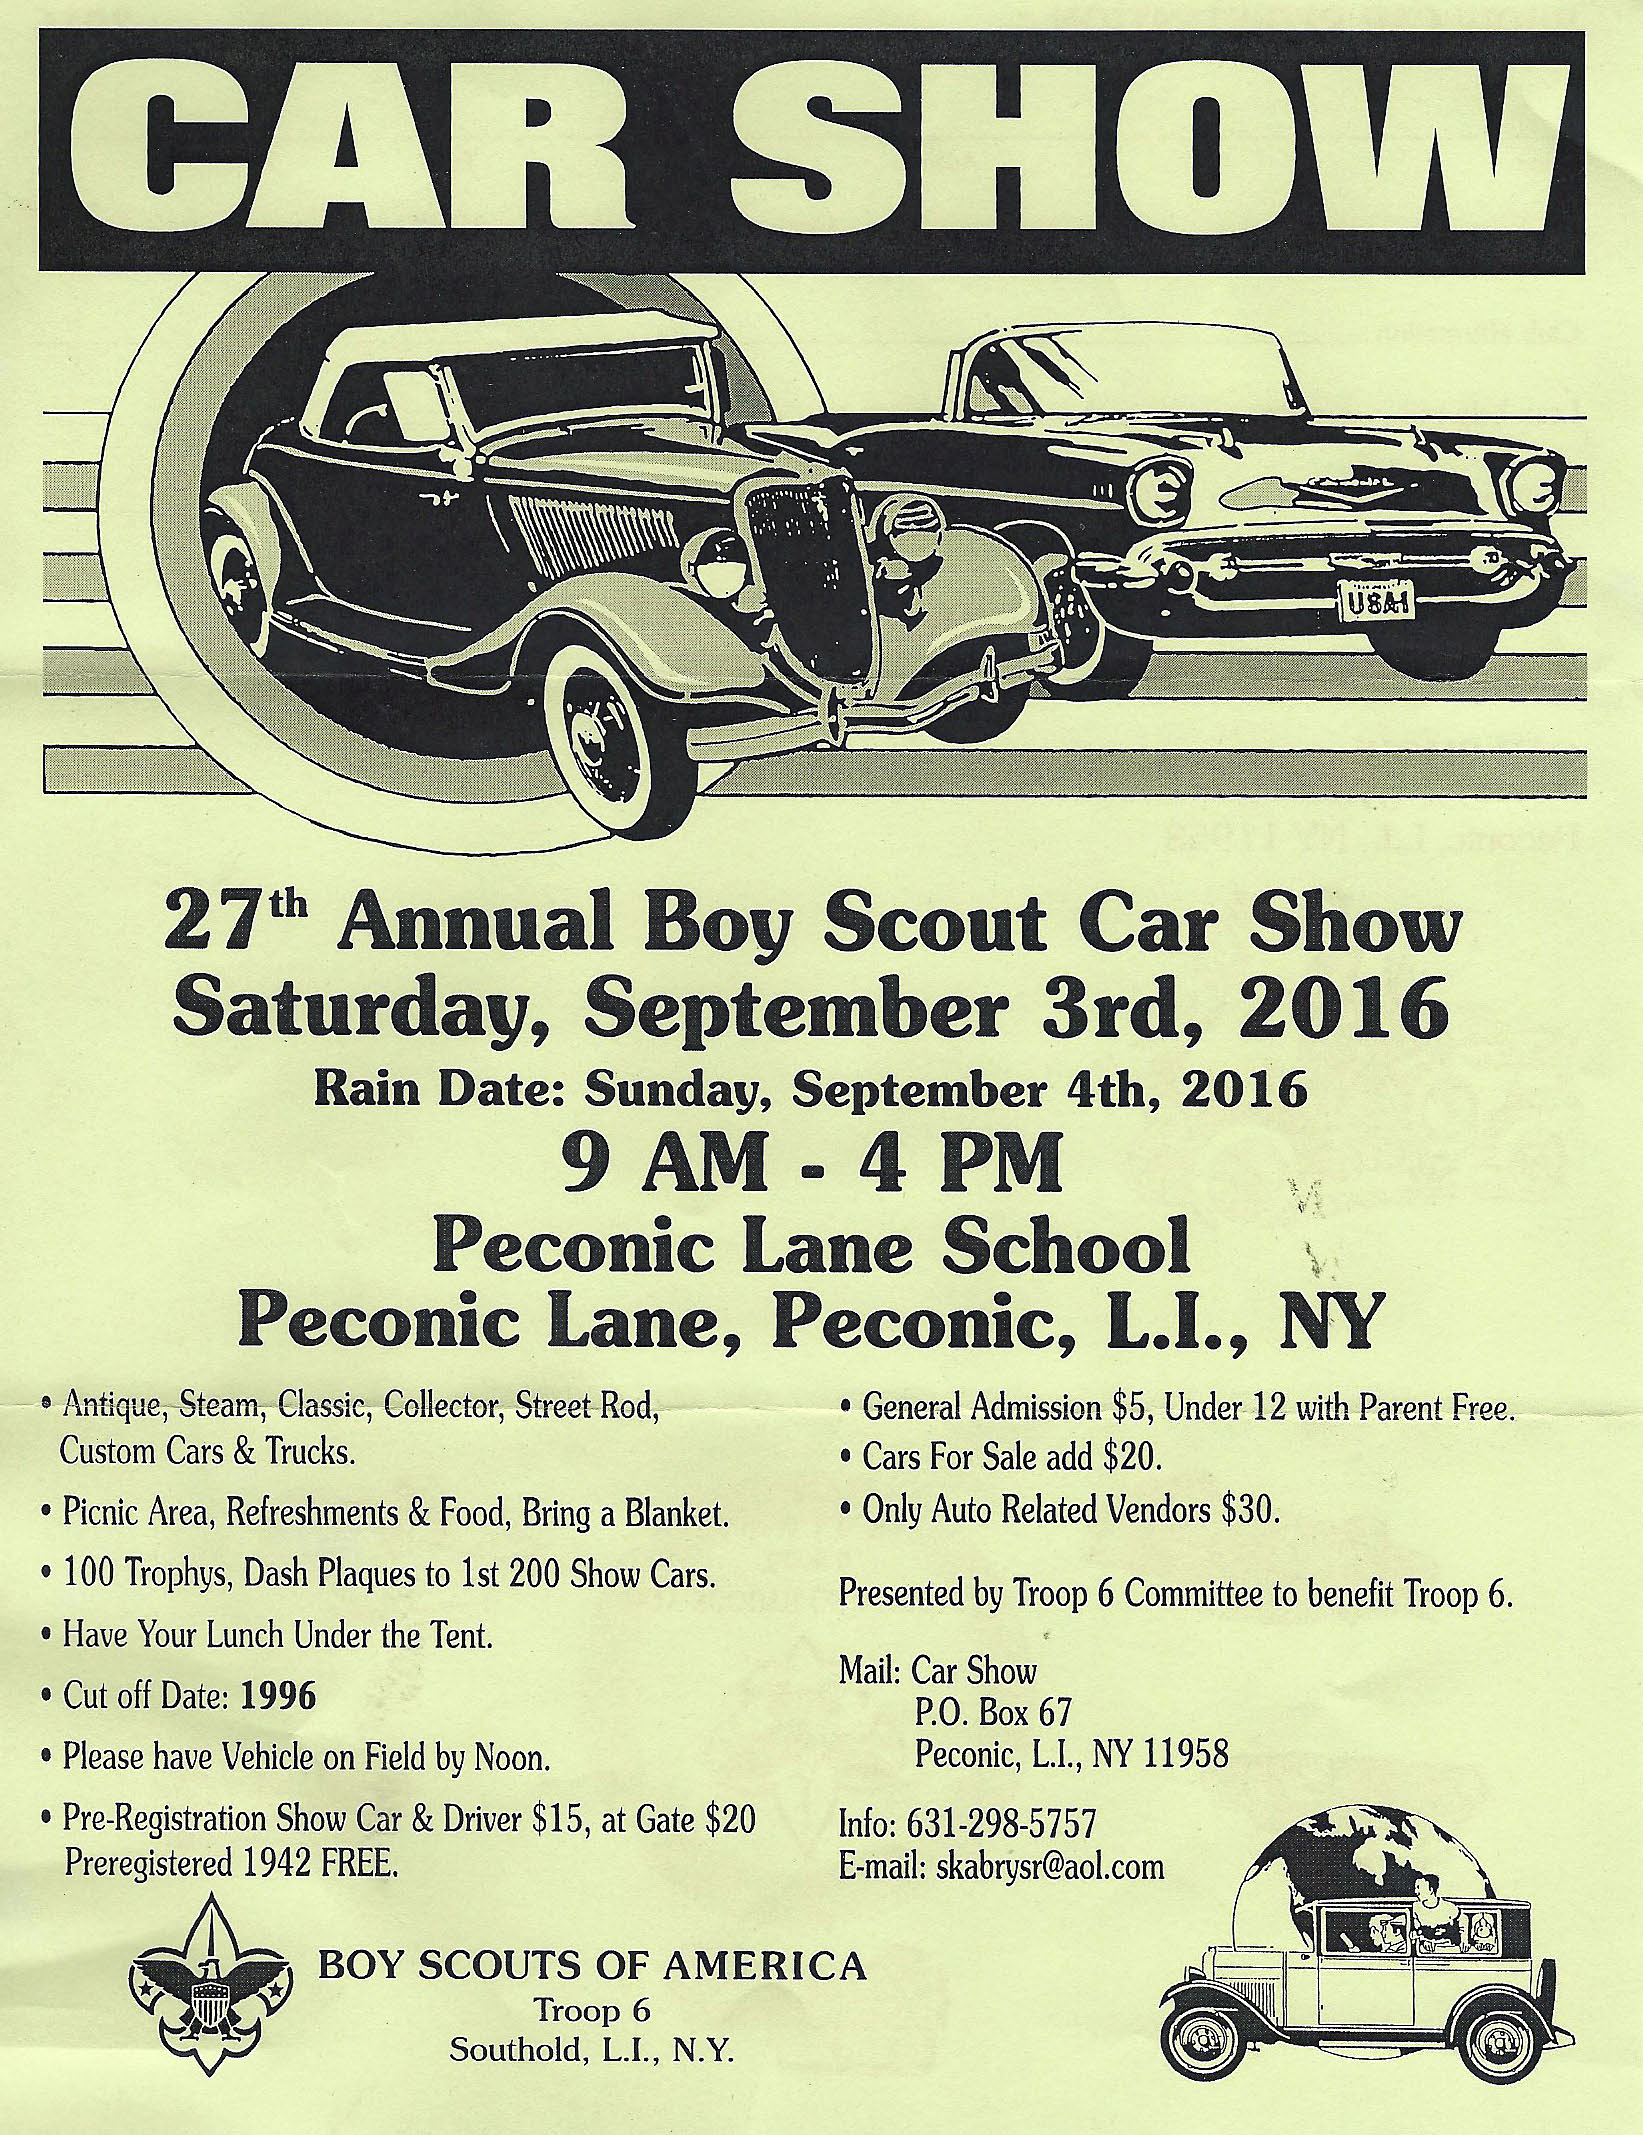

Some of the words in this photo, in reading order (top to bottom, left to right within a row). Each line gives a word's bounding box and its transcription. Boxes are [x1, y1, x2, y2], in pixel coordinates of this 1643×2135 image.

[70, 57, 637, 235] CAR
[730, 56, 1571, 238] SHOW
[164, 885, 309, 950] 27th
[336, 886, 615, 951] Annual
[644, 888, 795, 966] Boy
[823, 888, 1048, 952] Scout
[1079, 888, 1220, 953] Car
[1250, 887, 1464, 953] Show
[173, 972, 550, 1052] Saturday,
[584, 973, 1010, 1052] September
[1042, 973, 1203, 1049] 3rd,
[1239, 975, 1449, 1040] 2016
[314, 1067, 421, 1106] Rain
[438, 1068, 564, 1107] Date:
[584, 1067, 772, 1116] Sunday,
[792, 1068, 1049, 1116] September
[1067, 1068, 1160, 1114] 4th,
[1182, 1069, 1308, 1108] 2016
[561, 1129, 610, 1193] 9
[641, 1130, 770, 1192] AM
[859, 1130, 907, 1193] 4
[940, 1130, 1064, 1193] PM
[433, 1213, 715, 1273] Peconic
[742, 1214, 913, 1274] Lane
[942, 1213, 1191, 1275] School
[238, 1288, 520, 1348] Peconic
[547, 1289, 741, 1358] Lane,
[772, 1290, 1076, 1360] Peconic,
[1107, 1290, 1248, 1360] L.I.,
[1279, 1290, 1387, 1350] NY
[62, 1388, 168, 1425] Antique,
[179, 1388, 266, 1424] Steam,
[278, 1387, 372, 1425] Classic,
[384, 1388, 505, 1425] Collector,
[515, 1389, 592, 1420] Street
[600, 1389, 659, 1425] Rod,
[863, 1389, 962, 1421] General
[970, 1390, 1103, 1421] Admission
[1112, 1386, 1154, 1426] $5,
[1164, 1390, 1243, 1422] Under
[1253, 1390, 1287, 1421] 12
[1295, 1390, 1350, 1421] with
[1359, 1391, 1443, 1422] Parent
[1452, 1392, 1515, 1422] Free.
[59, 1434, 156, 1465] Custom
[166, 1434, 224, 1465] Cars
[233, 1434, 257, 1465] &
[265, 1434, 355, 1465] Trucks.
[863, 1440, 921, 1471] Cars
[930, 1440, 974, 1471] For
[983, 1439, 1037, 1471] Sale
[1046, 1440, 1093, 1471] add
[1103, 1436, 1162, 1474] $20.
[63, 1494, 139, 1526] Picnic
[147, 1494, 215, 1531] Area,
[226, 1494, 399, 1527] Refreshments
[408, 1495, 431, 1527] &
[440, 1495, 511, 1532] Food,
[522, 1496, 591, 1534] Bring
[601, 1506, 616, 1527] a
[625, 1495, 729, 1528] Blanket.
[862, 1491, 923, 1530] Only
[931, 1492, 992, 1524] Auto
[1001, 1492, 1098, 1524] Related
[1105, 1491, 1211, 1524] Vendors
[1221, 1489, 1280, 1528] $30.
[65, 1554, 114, 1587] 100
[124, 1554, 233, 1594] Trophys,
[244, 1554, 309, 1587] Dash
[318, 1555, 416, 1594] Plaques
[425, 1560, 451, 1588] to
[462, 1555, 500, 1588] 1st
[509, 1556, 560, 1588] 200
[570, 1556, 641, 1588] Show
[650, 1557, 716, 1589] Cars.
[839, 1575, 965, 1607] Presented
[973, 1575, 1004, 1614] by
[1012, 1576, 1088, 1614] Troop
[1098, 1576, 1114, 1608] 6
[1124, 1576, 1264, 1608] Committee
[1272, 1580, 1298, 1608] to
[1307, 1576, 1395, 1608] benefit
[1403, 1577, 1479, 1615] Troop
[1488, 1577, 1513, 1608] 6.
[63, 1618, 128, 1648] Have
[137, 1618, 197, 1648] Your
[207, 1618, 284, 1649] Lunch
[294, 1618, 372, 1649] Under
[380, 1618, 421, 1649] the
[429, 1619, 493, 1649] Tent.
[839, 1653, 900, 1685] Mail:
[911, 1654, 958, 1685] Car
[966, 1653, 1038, 1685] Show
[63, 1679, 108, 1710] Cut
[117, 1678, 153, 1709] off
[161, 1679, 228, 1710] Date:
[241, 1679, 316, 1710] 1996
[915, 1696, 968, 1727] P.O.
[979, 1696, 1029, 1726] Box
[1039, 1696, 1073, 1727] 67
[63, 1739, 144, 1770] Please
[153, 1740, 212, 1770] have
[221, 1740, 314, 1771] Vehicle
[323, 1749, 356, 1771] on
[364, 1740, 426, 1771] Field
[435, 1740, 466, 1779] by
[474, 1741, 550, 1772] Noon.
[915, 1737, 1021, 1774] Peconic,
[1032, 1738, 1082, 1774] L.I.,
[1092, 1738, 1134, 1769] NY
[1144, 1736, 1229, 1769] 11958
[63, 1802, 267, 1840] Pre-Registration
[276, 1801, 347, 1832] Show
[356, 1802, 403, 1832] Car
[412, 1802, 434, 1833] &
[443, 1803, 523, 1833] Driver
[532, 1799, 591, 1840] $15,
[601, 1806, 627, 1834] at
[636, 1803, 695, 1834] Gate
[705, 1799, 756, 1838] $20
[839, 1806, 896, 1838] Info:
[907, 1806, 1097, 1839] 631-298-5757
[65, 1845, 233, 1884] Preregistered
[244, 1845, 311, 1878] 1942
[321, 1846, 398, 1878] FREE.
[839, 1848, 926, 1880] E-mail:
[936, 1848, 1165, 1887] skabrysr@aol.com
[318, 1949, 405, 1980] BOY
[418, 1949, 581, 1980] SCOUTS
[596, 1949, 650, 1980] OF
[662, 1950, 868, 1981] AMERICA
[532, 1996, 621, 2028] Troop
[633, 1997, 651, 2023] 6
[449, 2035, 589, 2067] Southold,
[602, 2036, 660, 2067] L.I.,
[672, 2036, 734, 2063] N.Y.
